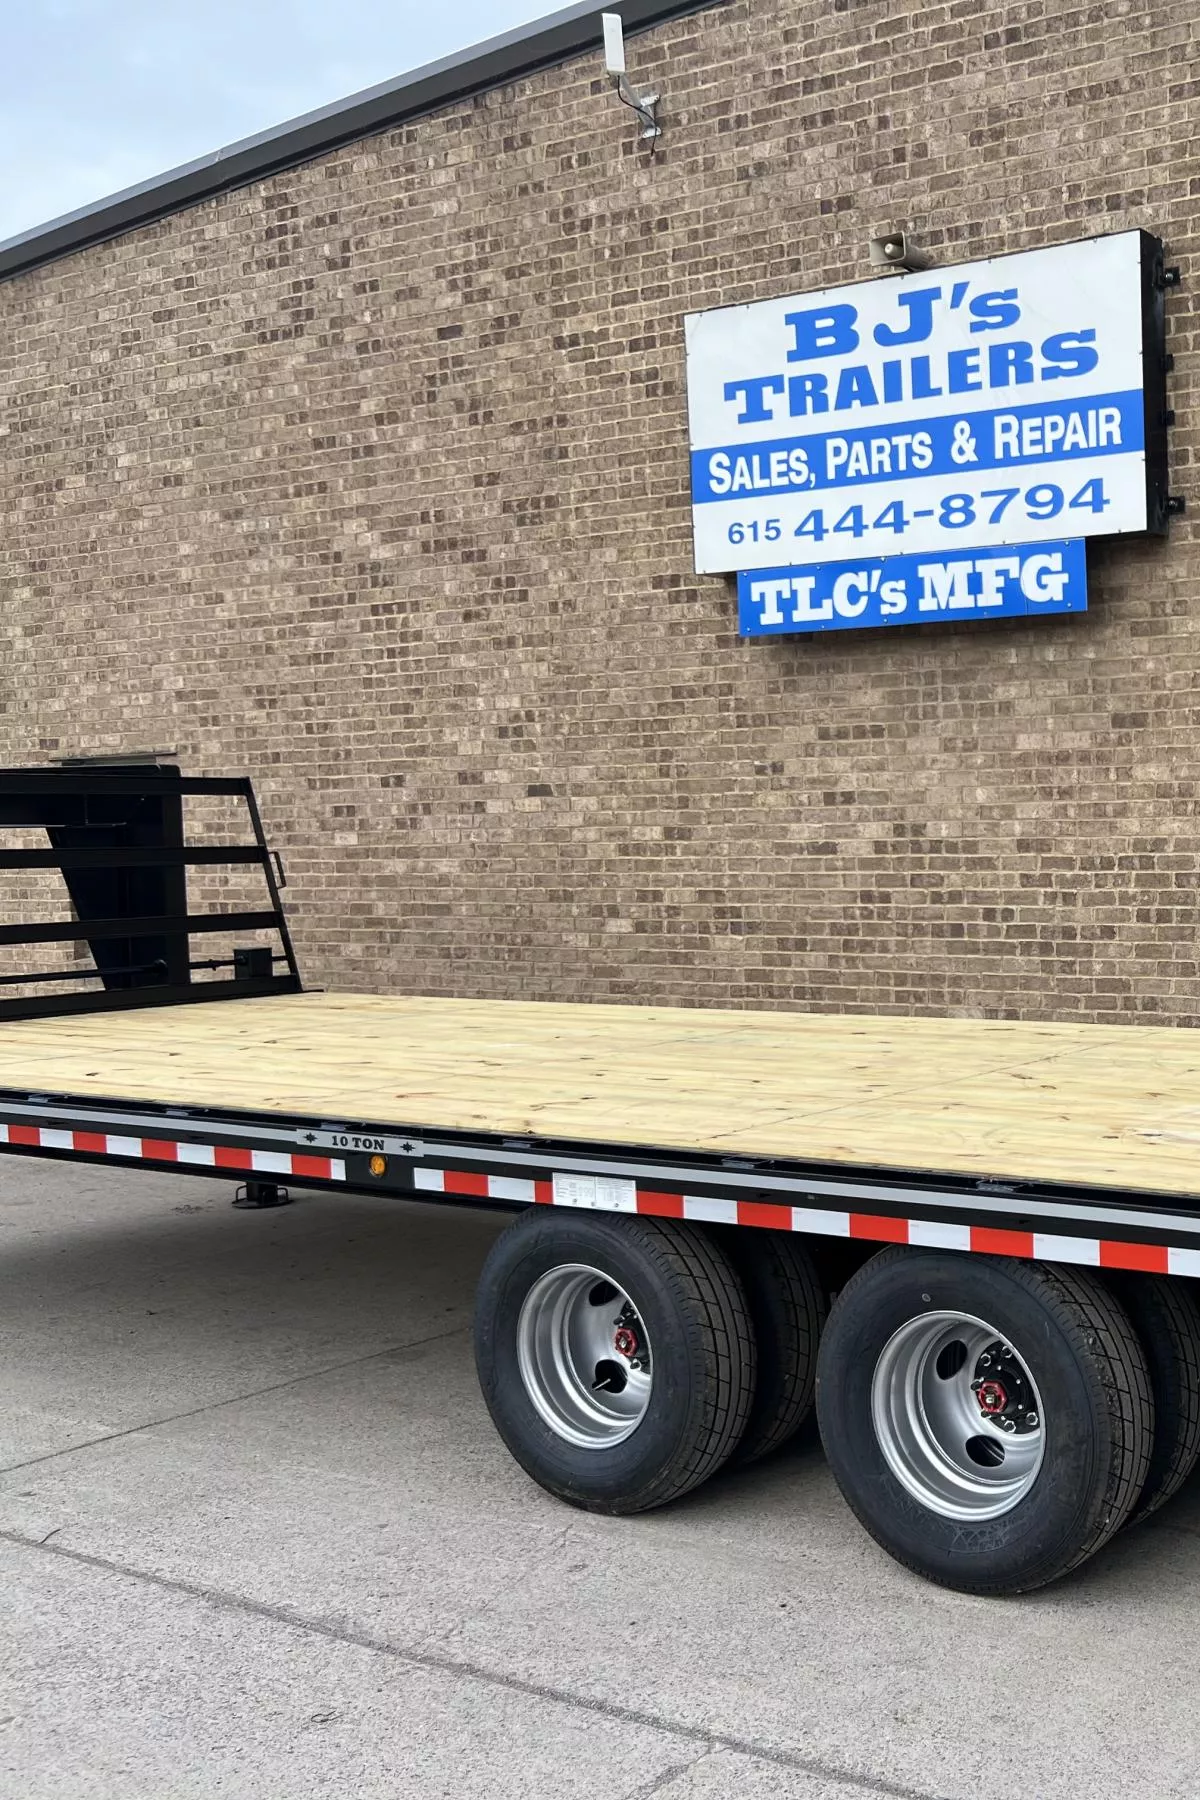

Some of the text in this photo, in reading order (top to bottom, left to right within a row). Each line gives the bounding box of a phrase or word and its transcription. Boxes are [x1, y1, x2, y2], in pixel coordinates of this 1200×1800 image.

[723, 328, 1099, 424] TRAILERS
[708, 407, 1123, 494] SALES, PARTS & REPAIR
[727, 478, 1111, 545] 615 444-8794
[750, 552, 1069, 626] TLC's MFG
[331, 1135, 385, 1151] 10 TON
